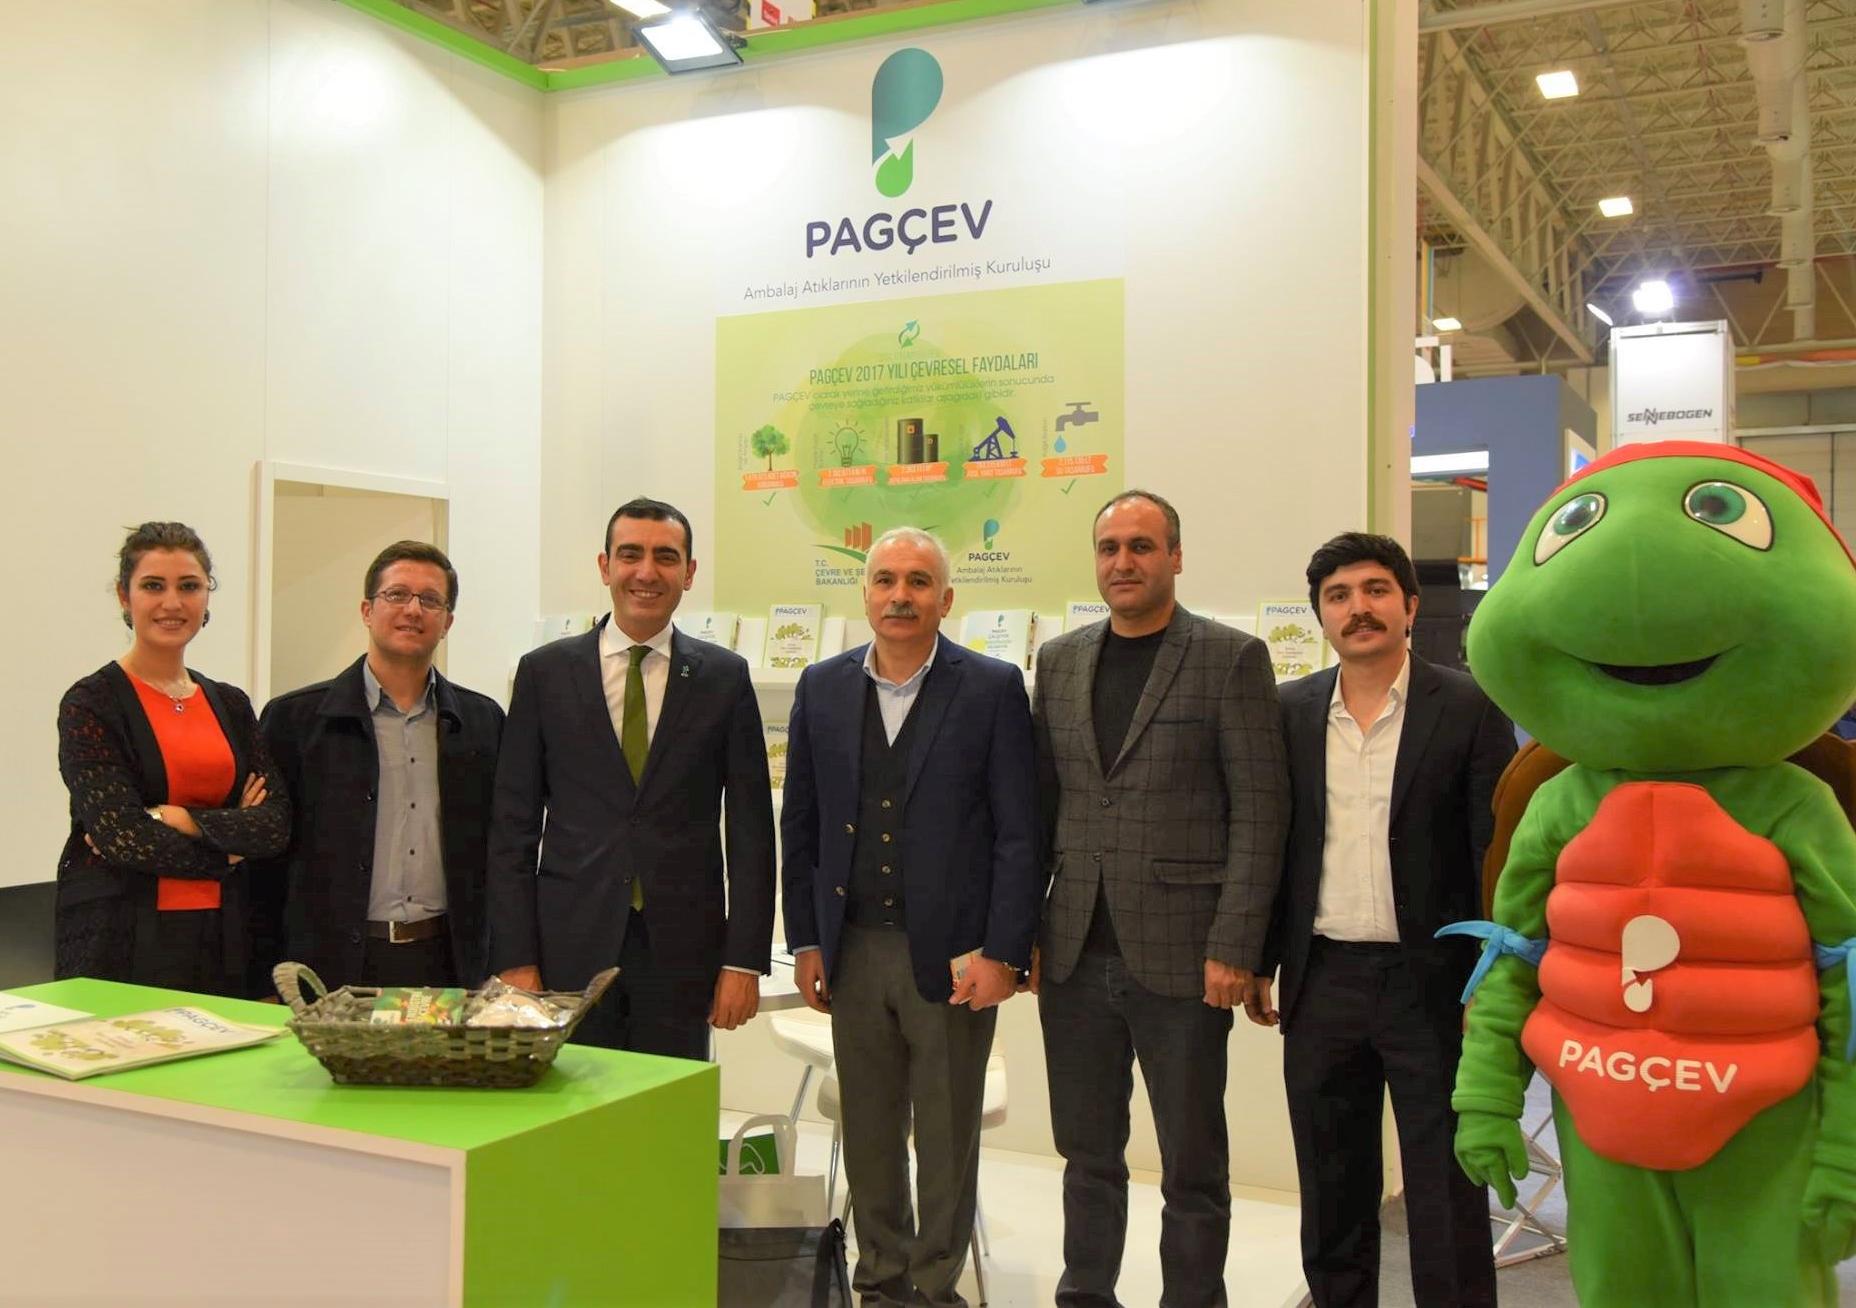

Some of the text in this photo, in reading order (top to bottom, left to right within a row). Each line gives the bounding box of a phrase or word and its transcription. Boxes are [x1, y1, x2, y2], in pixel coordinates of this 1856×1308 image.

[806, 199, 993, 258] PAGÇEV
[744, 255, 1051, 300] Ambalaj Atıklarının Yetkilendirilmiş Kuruluşu
[809, 352, 1039, 386] PAGÇEV 2017 YILI ÇEVRESEL FAYDALARI
[1627, 408, 1713, 426] SENNEBOGEN
[968, 552, 1010, 562] PAGÇEV
[815, 568, 842, 578] ÇEVRE
[843, 568, 855, 577] VE
[956, 566, 985, 576] Ambalaj
[815, 577, 859, 586] BAKANLIĞI
[951, 576, 1000, 585] etkilendirilmiş
[1558, 1039, 1738, 1094] PAGÇEV
